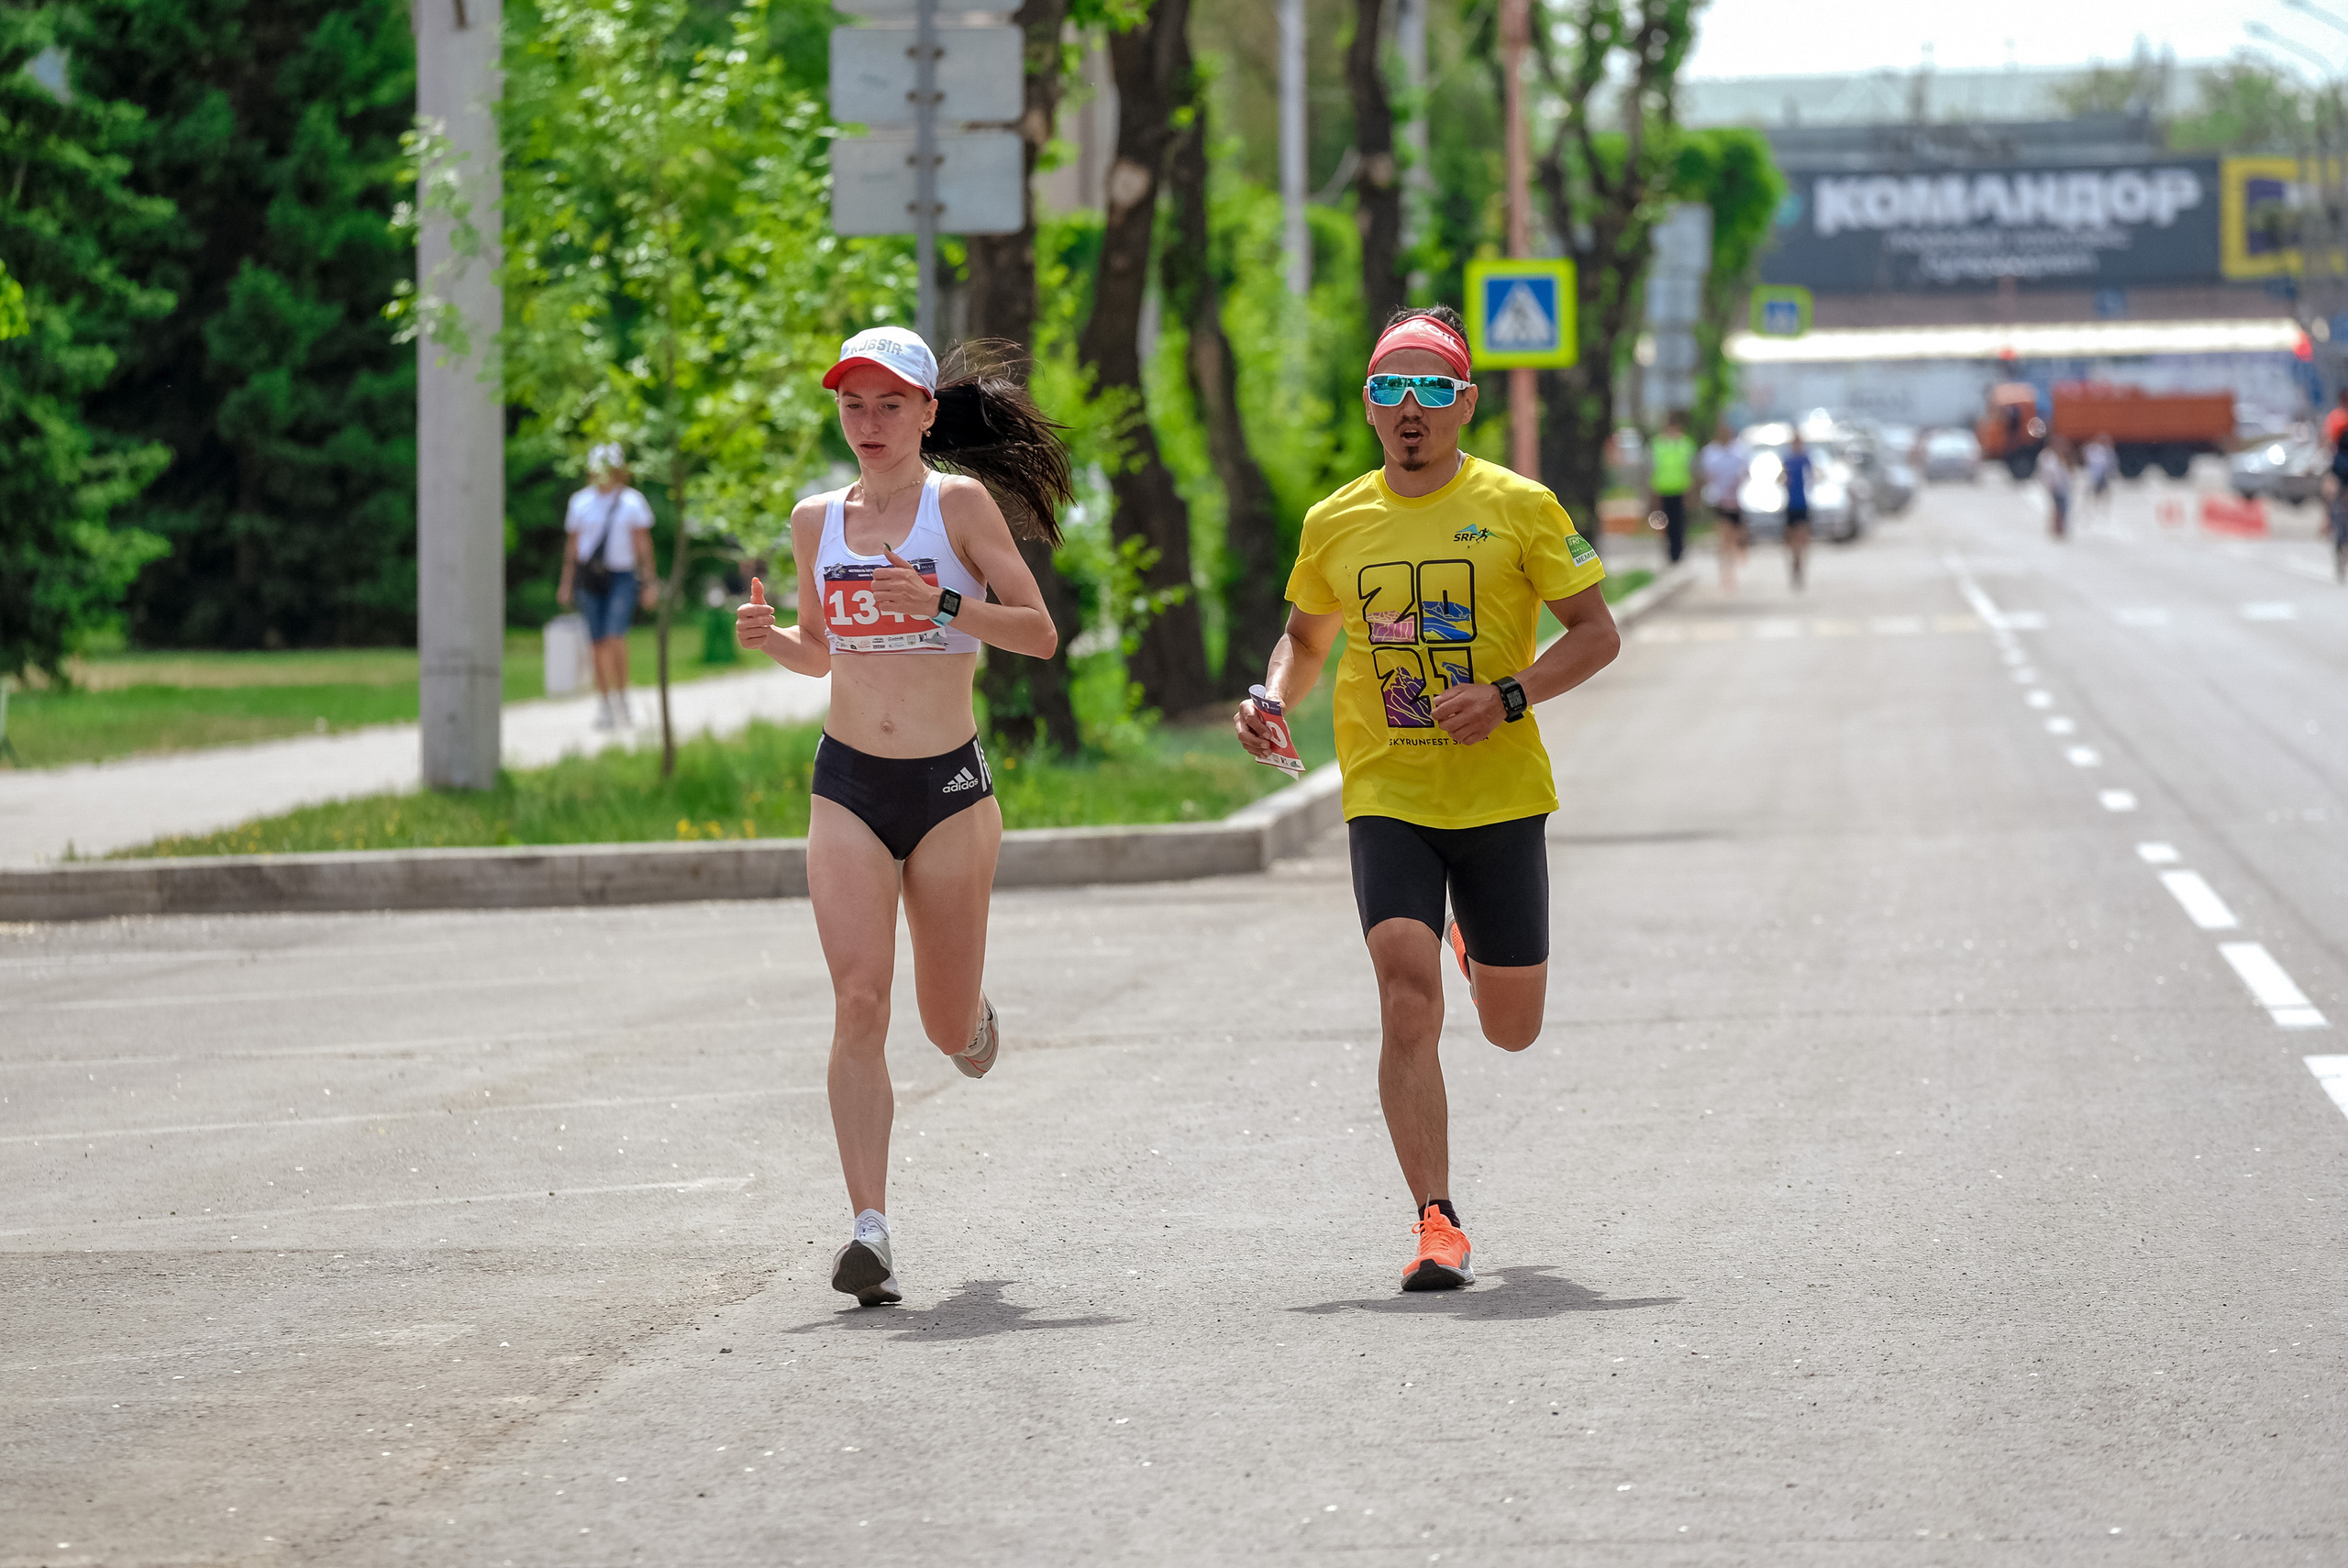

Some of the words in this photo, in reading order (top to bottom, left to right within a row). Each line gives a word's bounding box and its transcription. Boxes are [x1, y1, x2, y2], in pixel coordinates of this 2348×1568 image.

[1813, 170, 2199, 235] КОМАНДОР
[1454, 534, 1477, 542] SRF
[829, 590, 930, 626] 13
[1358, 558, 1478, 646] 20
[1389, 737, 1449, 746] SKYRUNFEST
[942, 778, 979, 793] adidas
